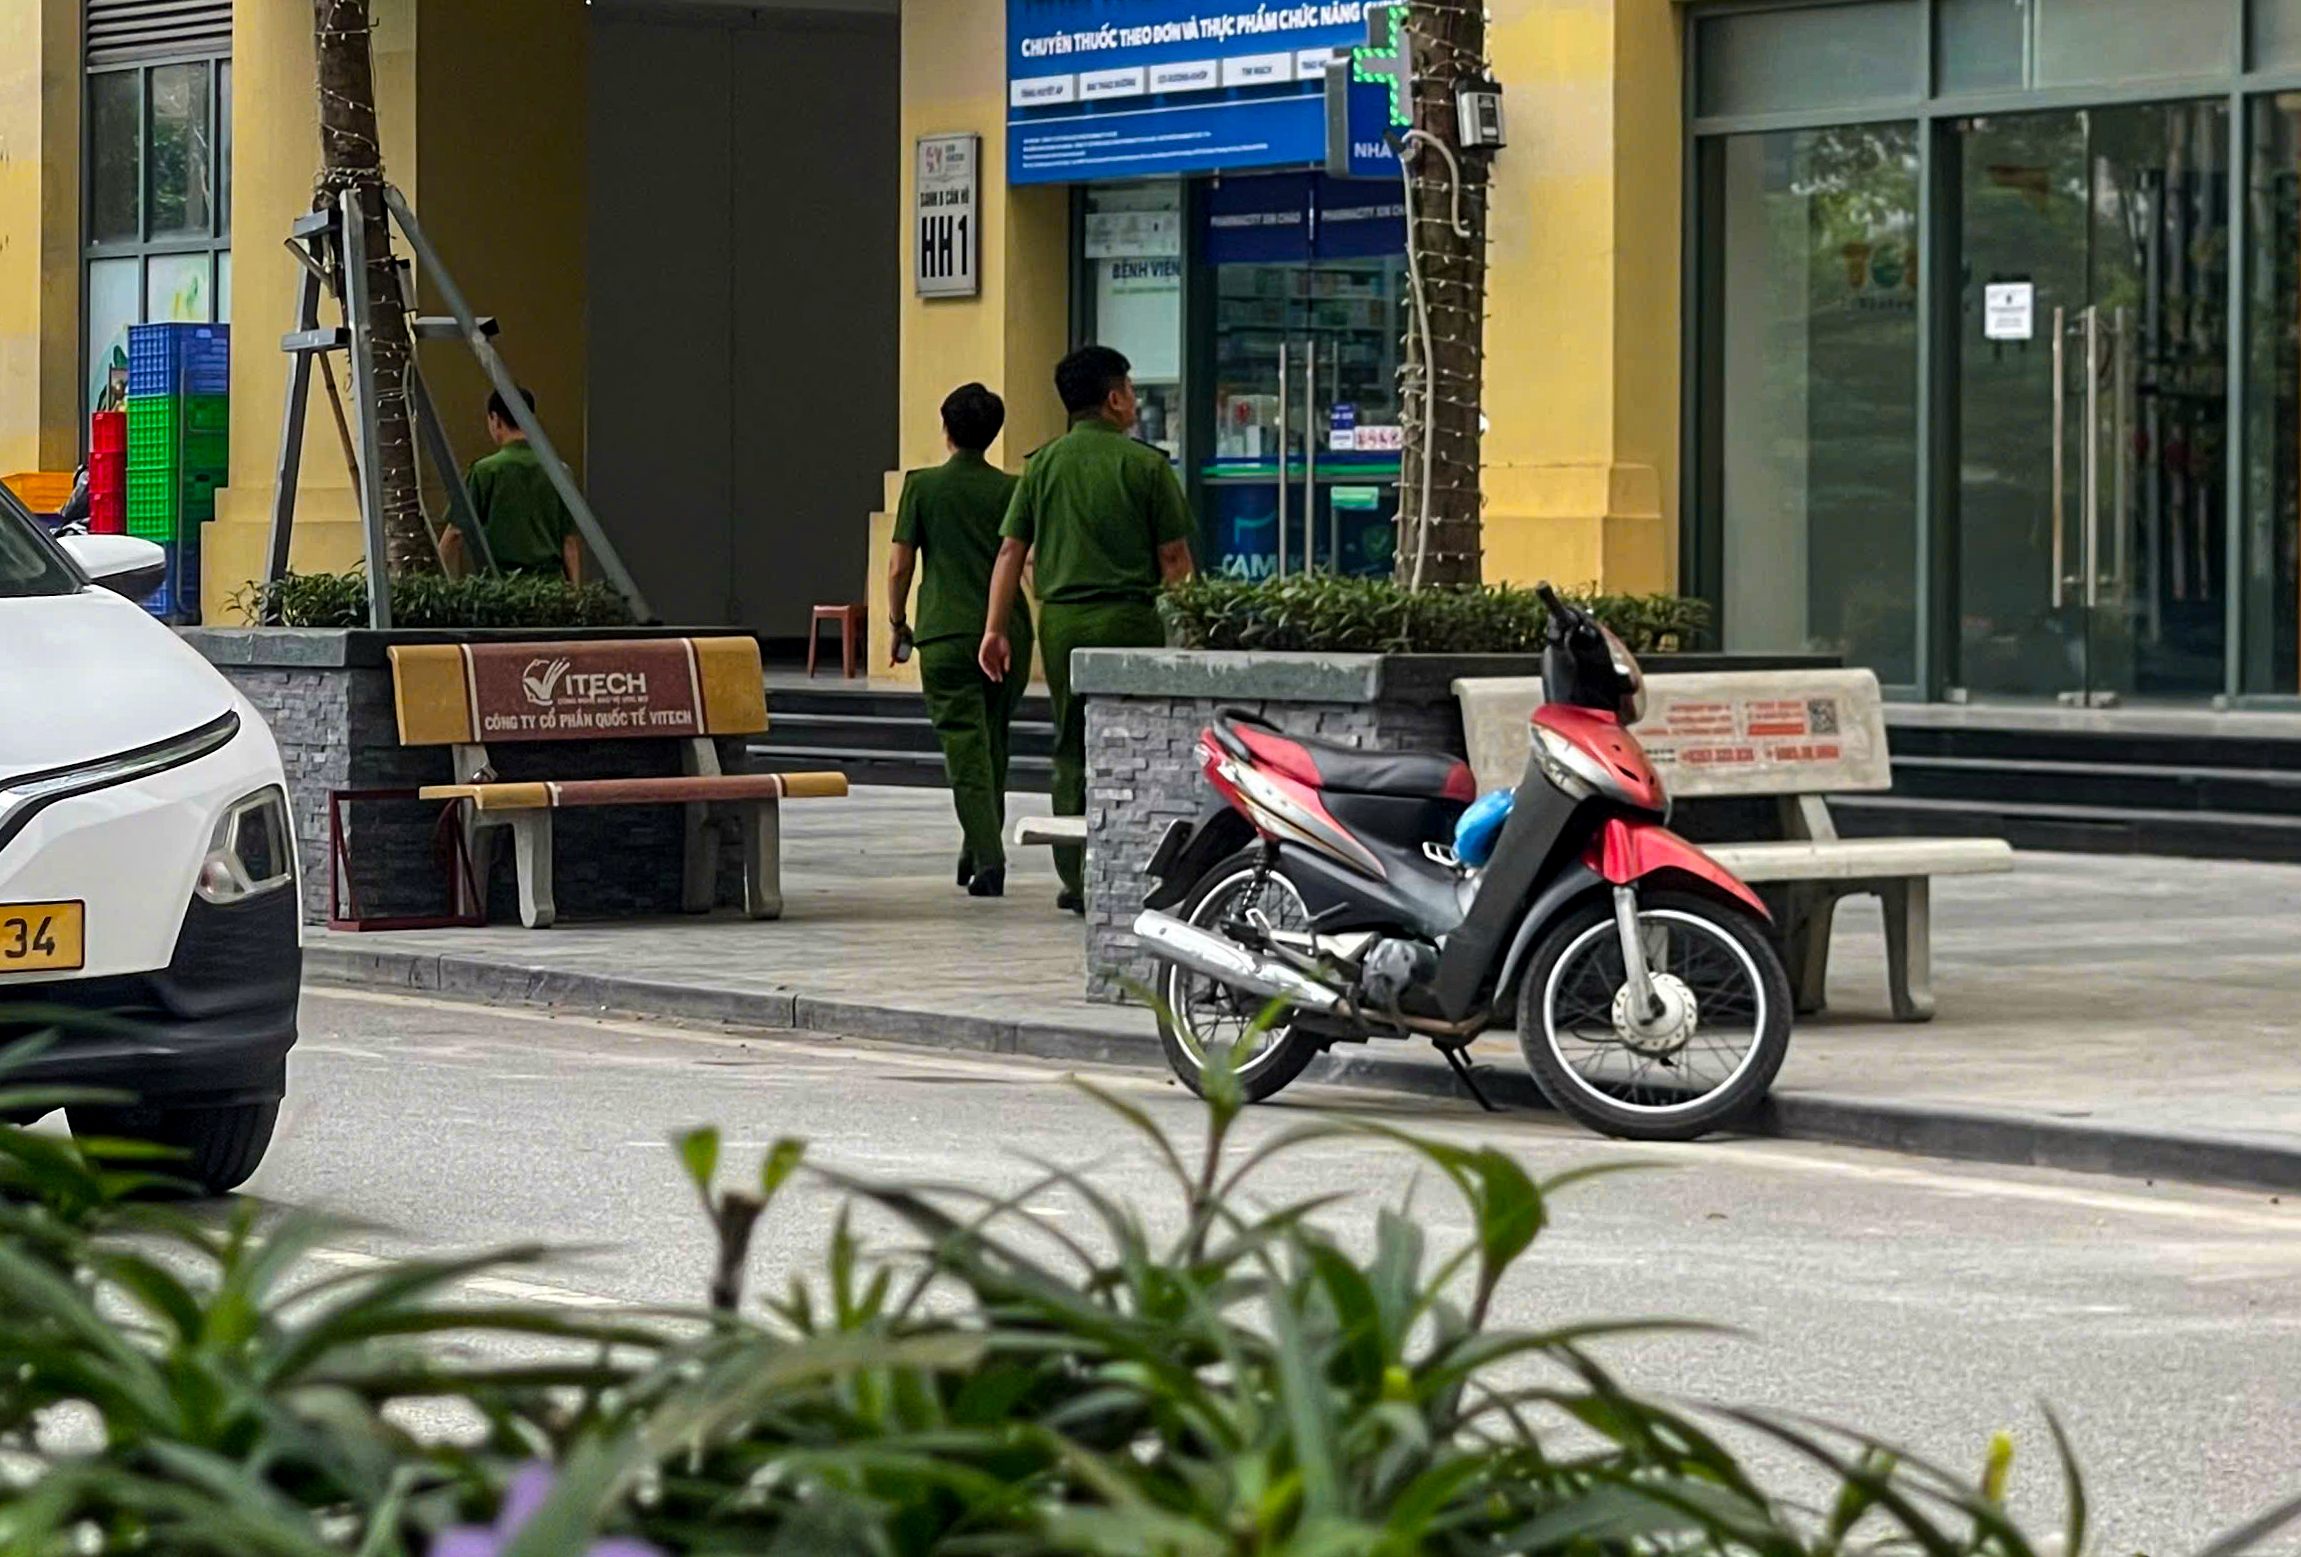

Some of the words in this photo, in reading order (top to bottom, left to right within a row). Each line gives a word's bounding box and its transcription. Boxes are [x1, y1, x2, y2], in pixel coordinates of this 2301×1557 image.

[1073, 22, 1118, 51] THUỐC
[1119, 25, 1150, 47] THEO
[921, 215, 967, 278] HH1
[484, 713, 518, 730] CÔNG
[520, 715, 537, 729] TY
[540, 707, 556, 729] CỔ
[595, 706, 628, 728] QUỐC
[630, 706, 646, 726] TẾ
[650, 710, 692, 726] VITECH
[4, 916, 56, 958] 34
